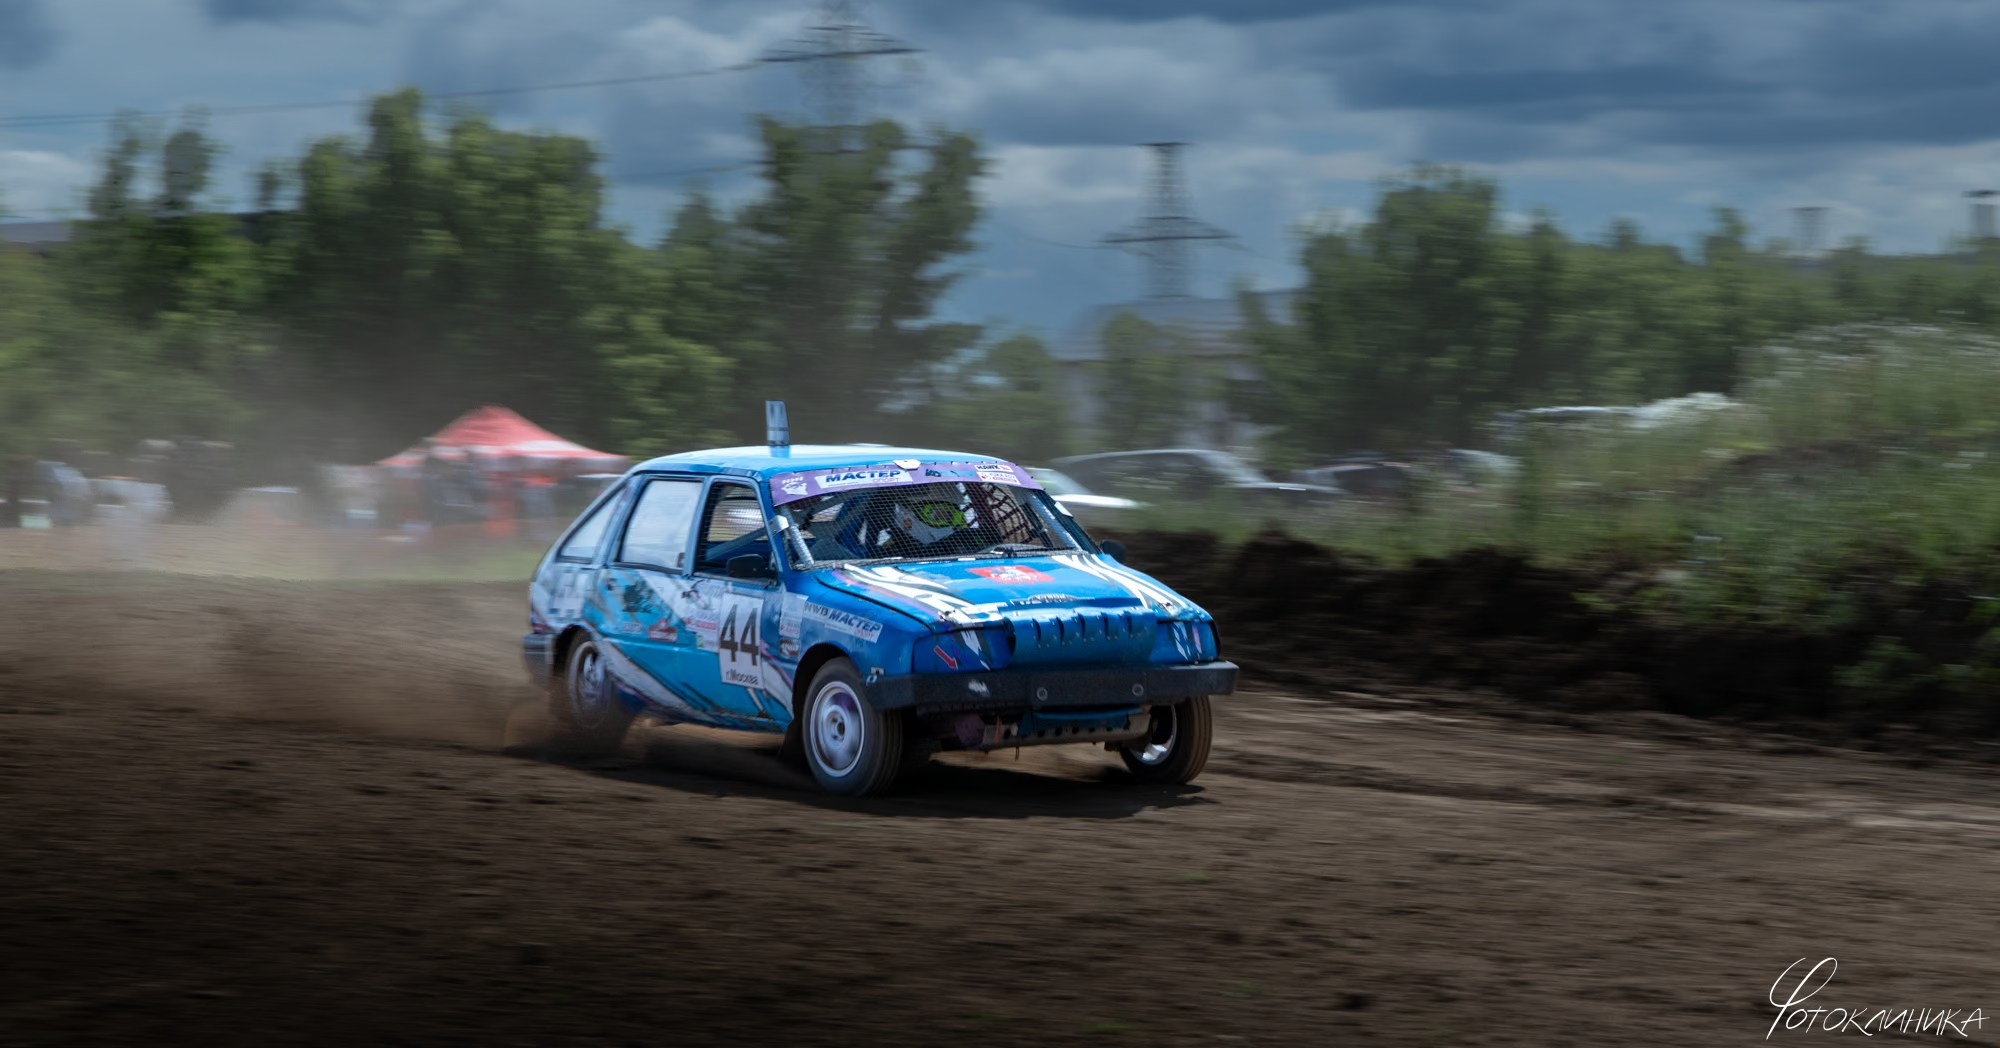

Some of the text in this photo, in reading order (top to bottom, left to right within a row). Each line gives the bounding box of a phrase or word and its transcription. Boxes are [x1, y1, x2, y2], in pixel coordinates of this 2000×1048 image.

[825, 470, 901, 482] МАСТЕР
[829, 610, 880, 632] МАСТЕР
[719, 604, 759, 666] 44
